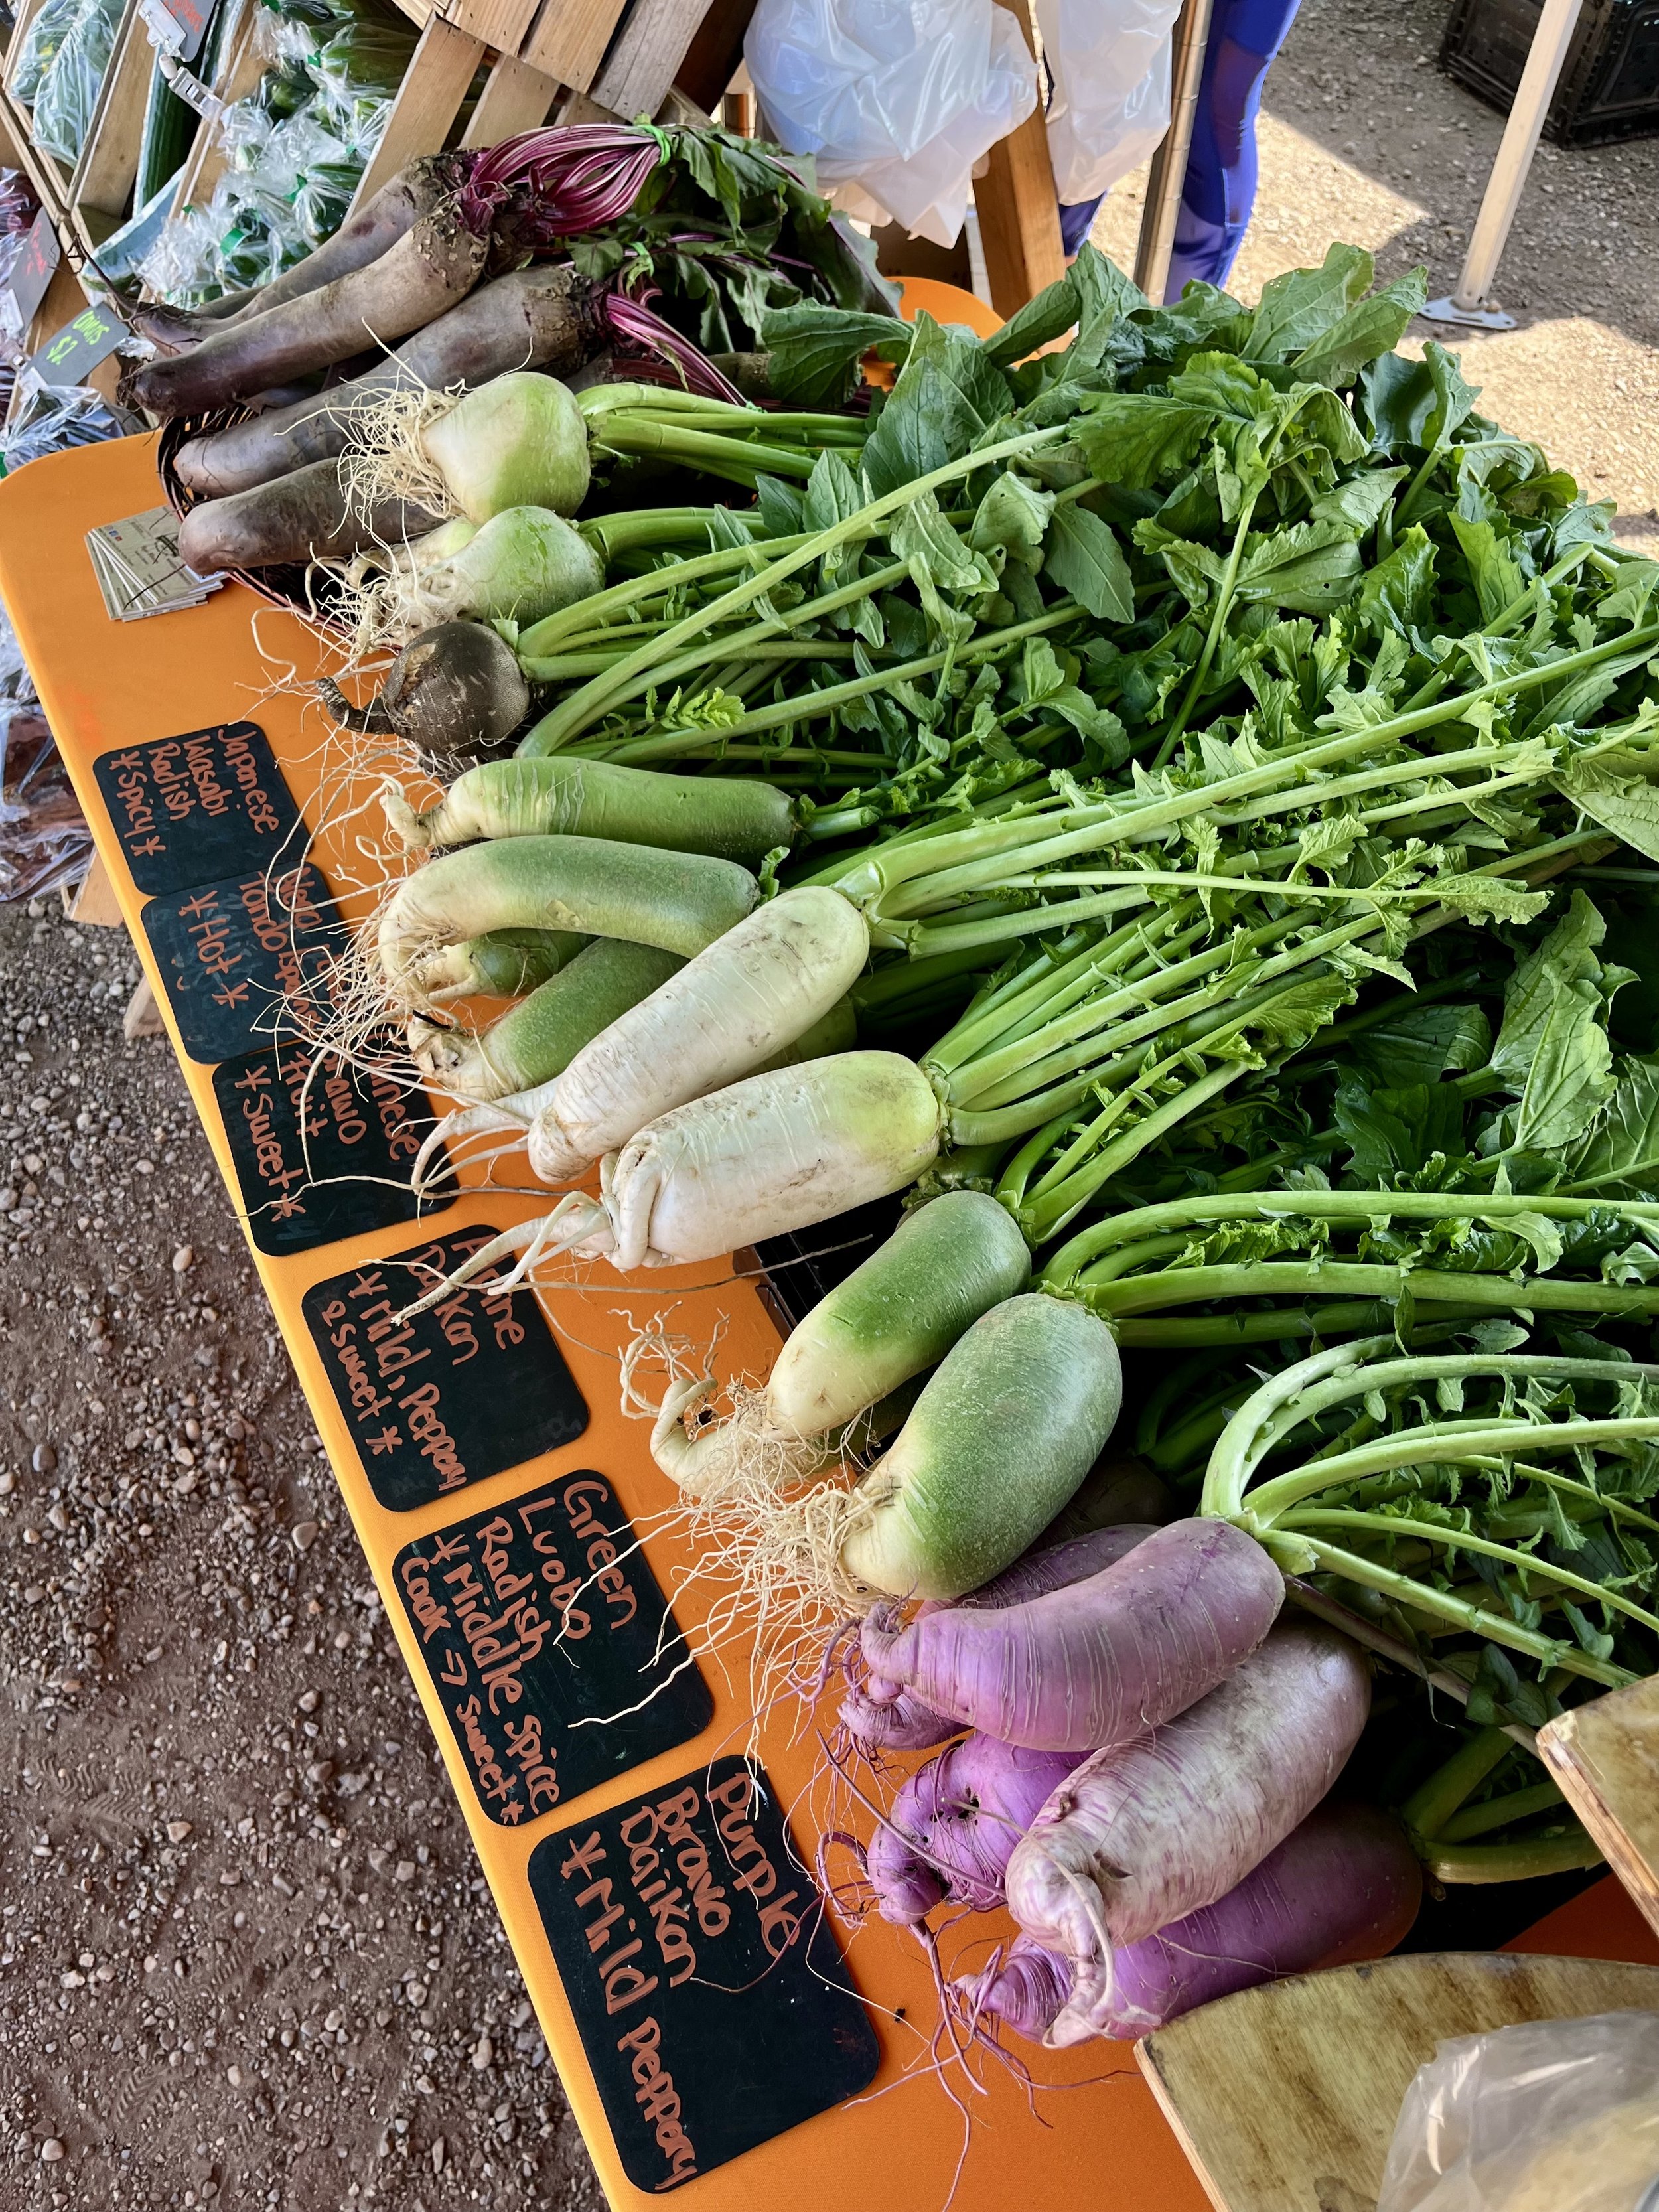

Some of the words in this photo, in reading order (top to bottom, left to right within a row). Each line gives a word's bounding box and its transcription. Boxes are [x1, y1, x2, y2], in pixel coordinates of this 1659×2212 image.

[149, 743, 195, 819] Radish
[183, 735, 240, 816] Wasabi
[218, 729, 279, 834] Japanese
[240, 872, 289, 952] Tondo
[279, 1051, 329, 1138] Fruit
[401, 1557, 451, 1644] Cook
[476, 1516, 551, 1662] Radish
[518, 1497, 591, 1639] Luobo
[564, 1480, 637, 1630] Green
[503, 1714, 560, 1815] Spice
[620, 1805, 697, 1988] Daikon
[656, 1786, 731, 1937] Bravo
[704, 1772, 800, 1958] Purple
